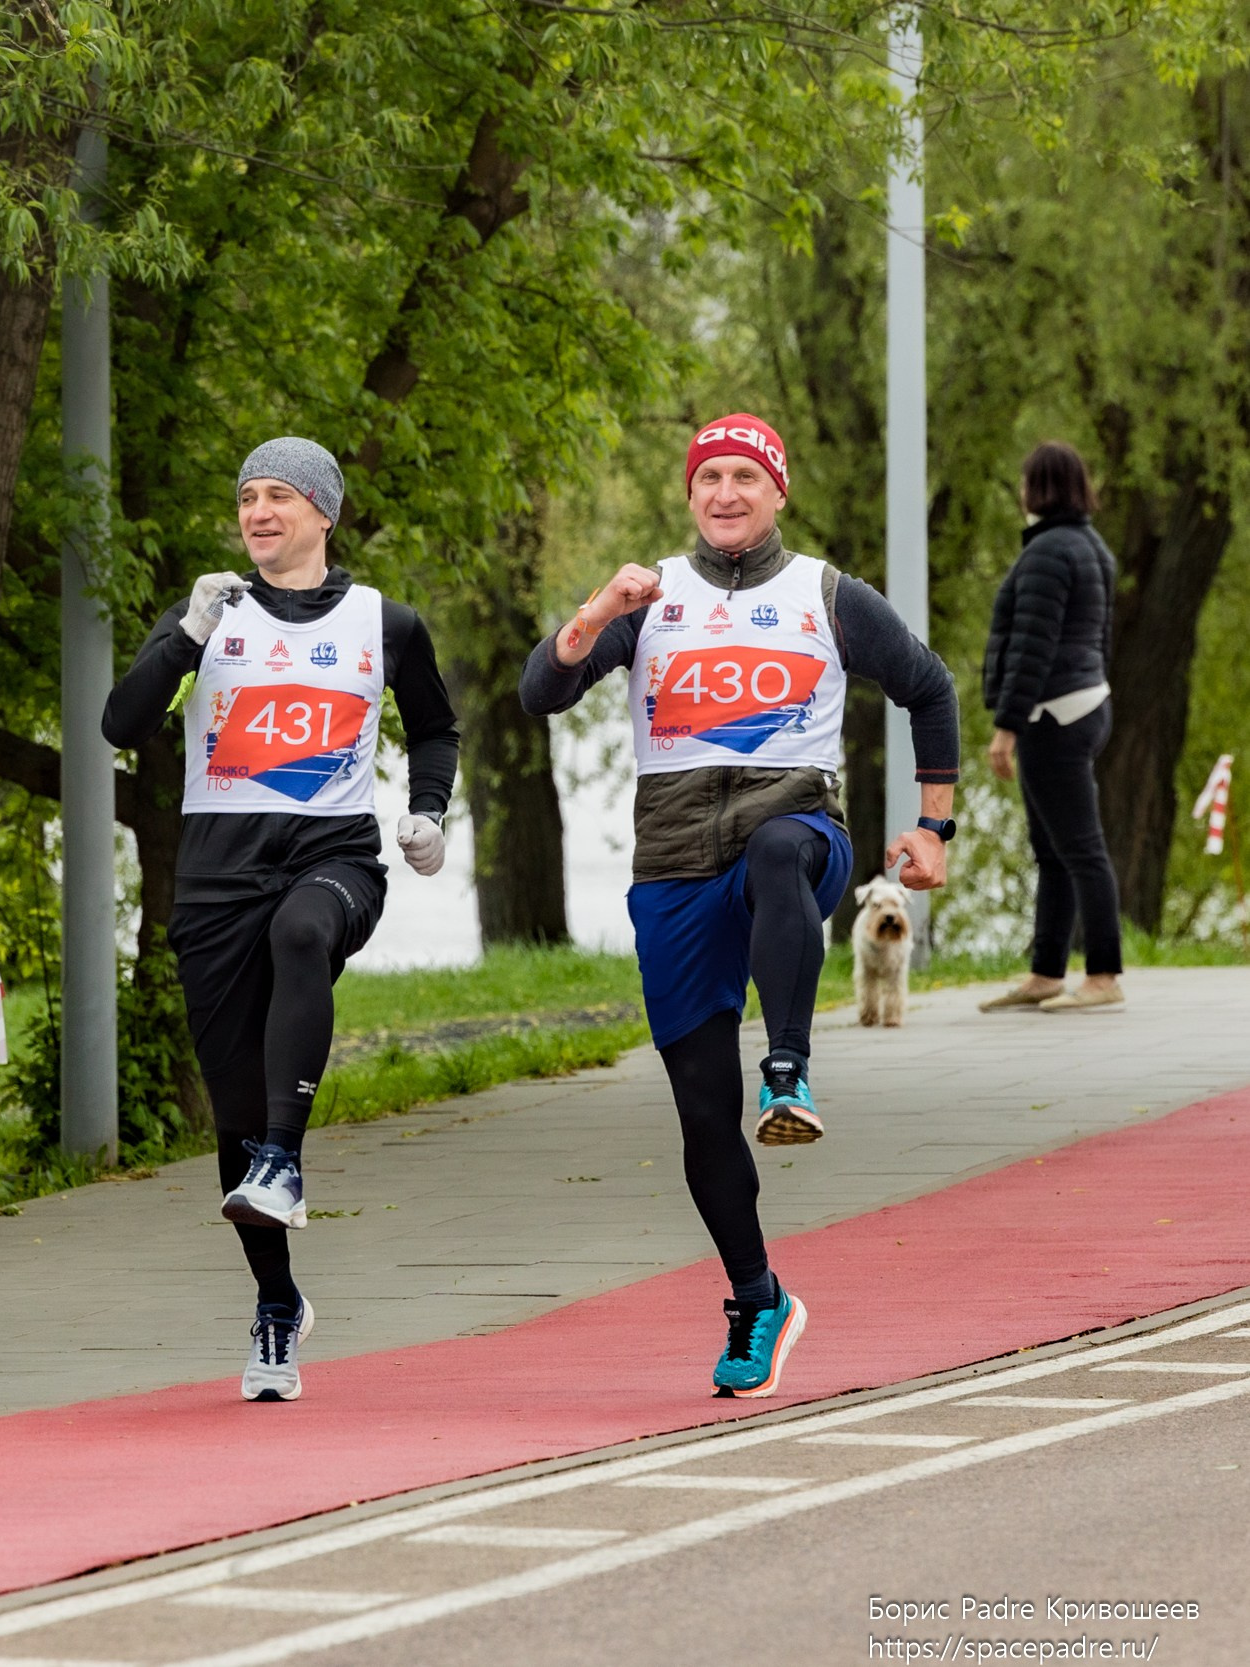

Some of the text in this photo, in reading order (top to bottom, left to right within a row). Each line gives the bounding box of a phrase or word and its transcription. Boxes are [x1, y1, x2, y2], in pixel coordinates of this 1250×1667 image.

[670, 661, 792, 704] 430
[245, 700, 333, 747] 431
[207, 777, 232, 791] ГТО
[314, 876, 356, 909] ENERGY
[771, 1061, 793, 1069] HOKA
